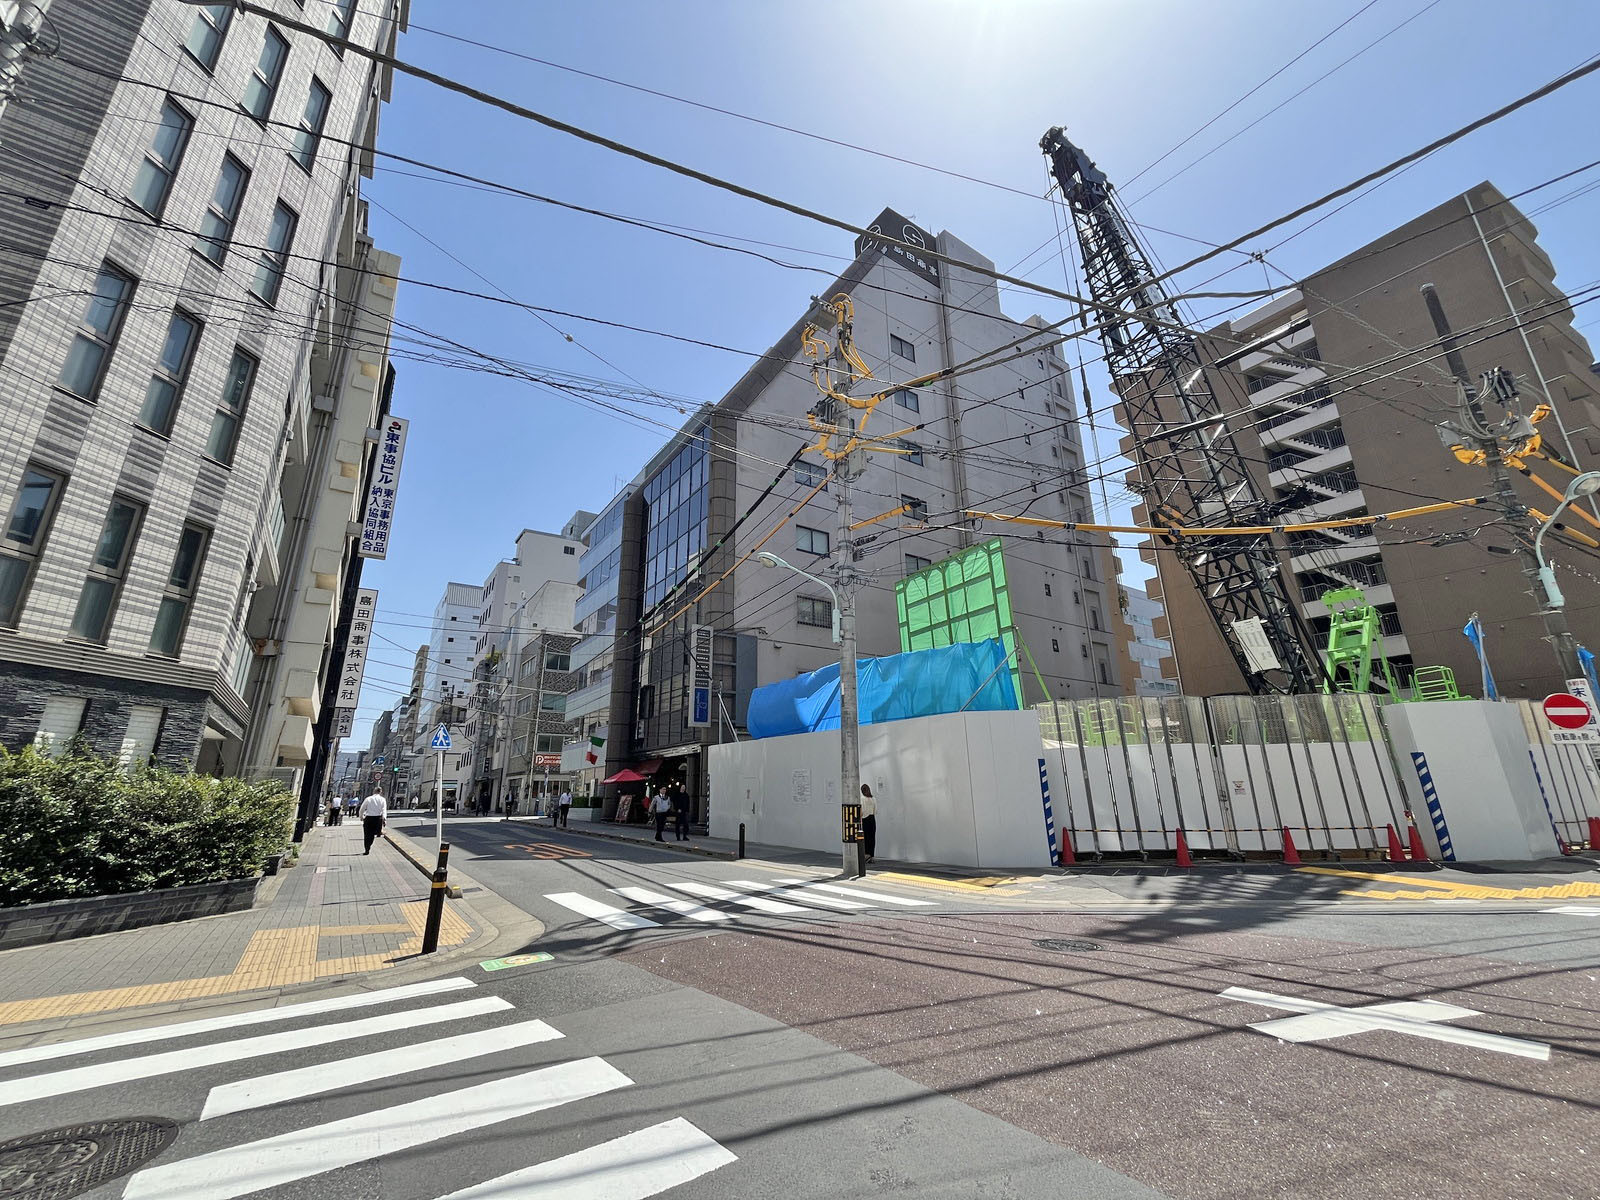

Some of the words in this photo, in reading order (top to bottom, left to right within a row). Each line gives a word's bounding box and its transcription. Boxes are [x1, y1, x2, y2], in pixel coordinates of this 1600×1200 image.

[378, 432, 400, 484] 東事協ビル
[362, 486, 382, 551] 納入協同組合
[373, 488, 394, 553] 東京事務用品
[340, 596, 372, 699] 島田商事株式会社
[503, 842, 593, 859] 30
